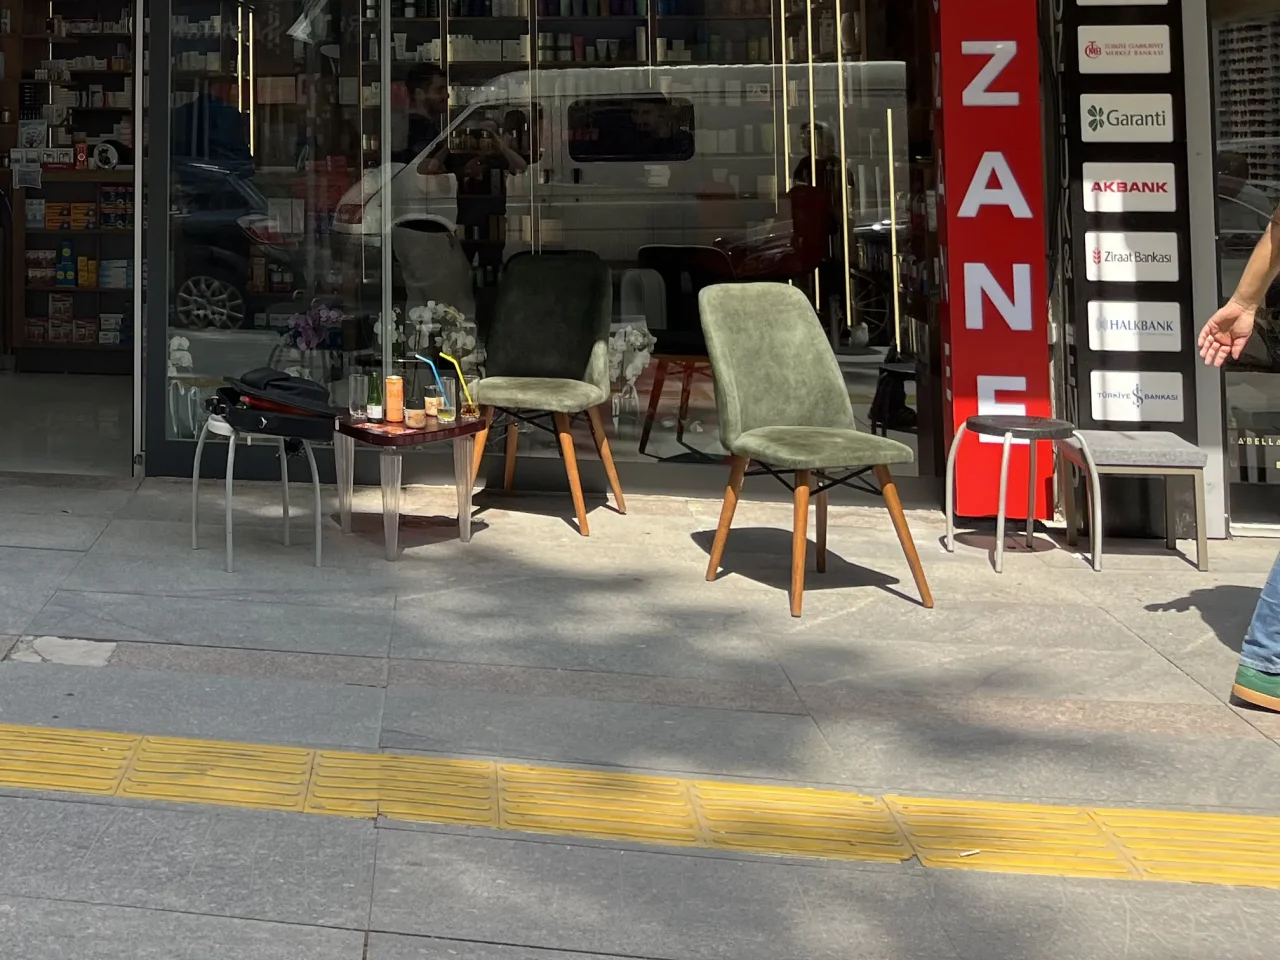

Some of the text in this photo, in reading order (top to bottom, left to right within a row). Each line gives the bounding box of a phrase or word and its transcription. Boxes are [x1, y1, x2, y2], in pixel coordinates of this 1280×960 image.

[1107, 109, 1166, 127] Garanti
[1090, 181, 1168, 193] AKBANK
[1104, 251, 1172, 263] Ziraat Bankası
[1109, 319, 1174, 332] HALKBANK
[1097, 390, 1131, 399] TÜRKİYE
[1144, 393, 1178, 401] BANKASI
